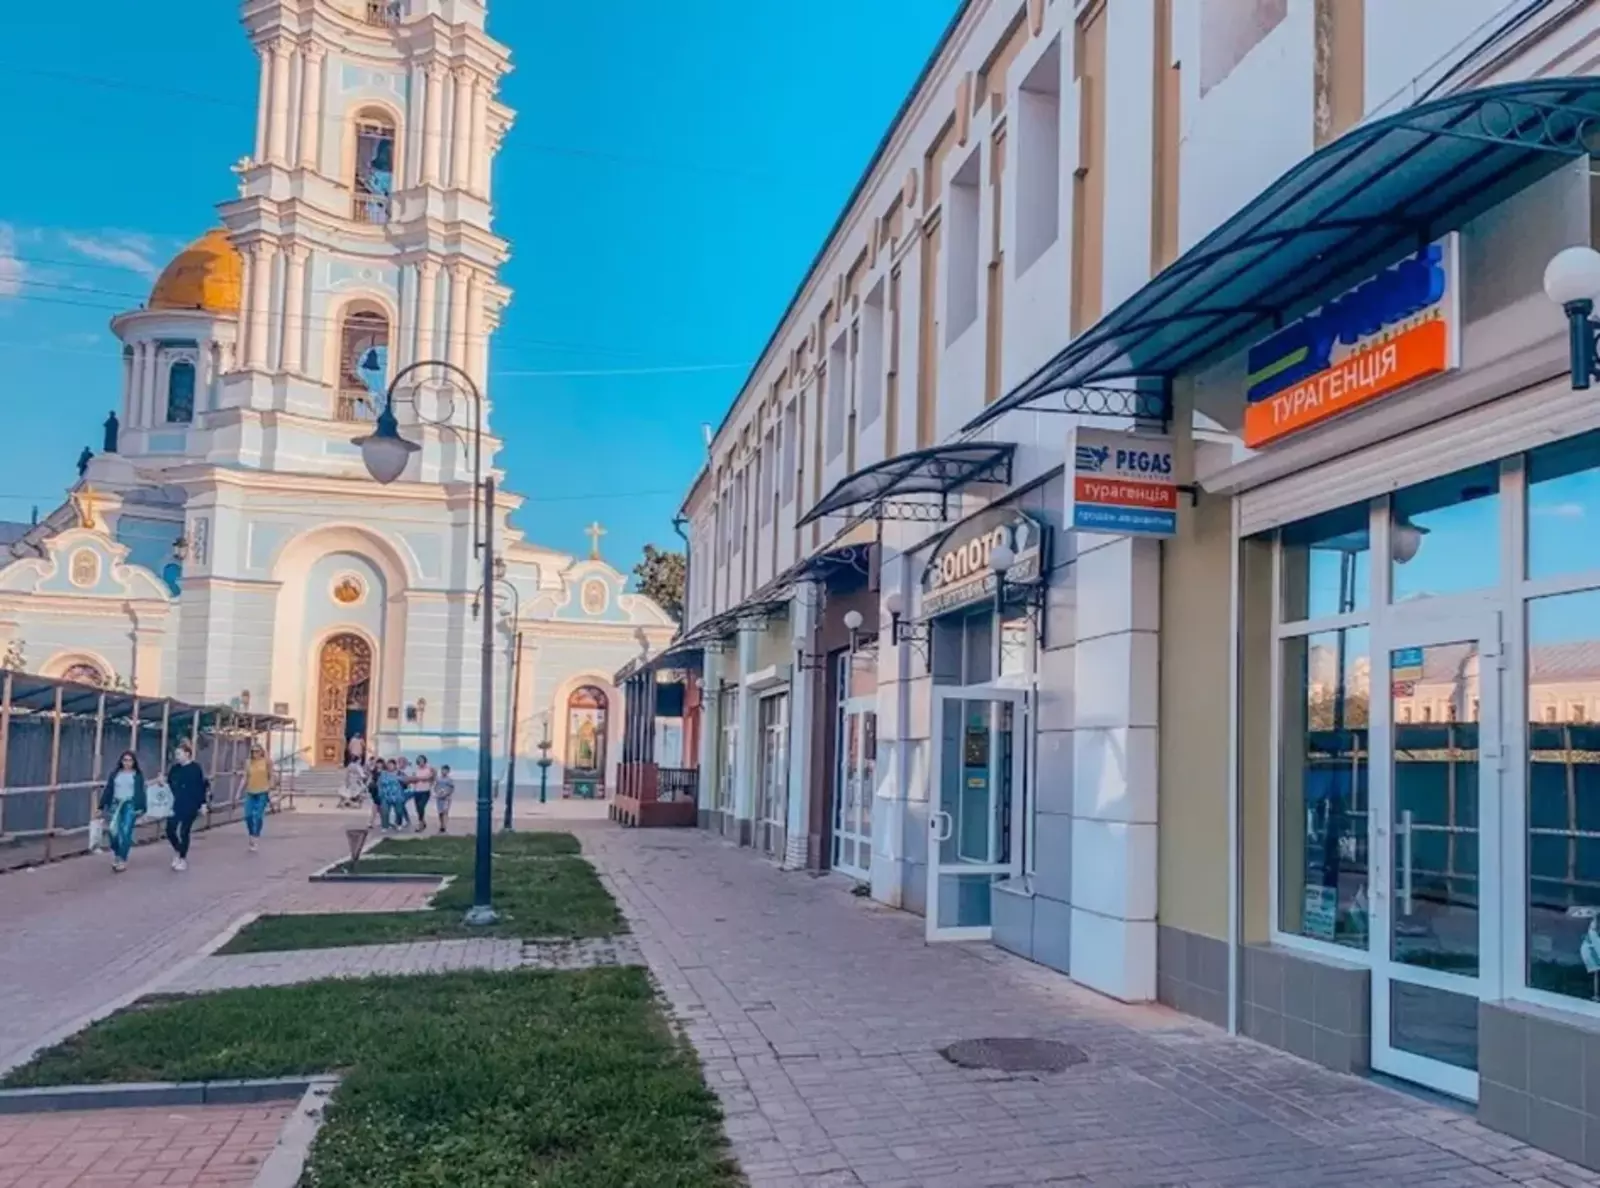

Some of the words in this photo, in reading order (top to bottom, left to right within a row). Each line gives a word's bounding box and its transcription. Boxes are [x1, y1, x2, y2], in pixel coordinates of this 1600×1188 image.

[1272, 344, 1396, 424] ТУРАГЕНЦІЯ
[1116, 449, 1172, 474] PEGAS
[1084, 483, 1169, 503] турагенція
